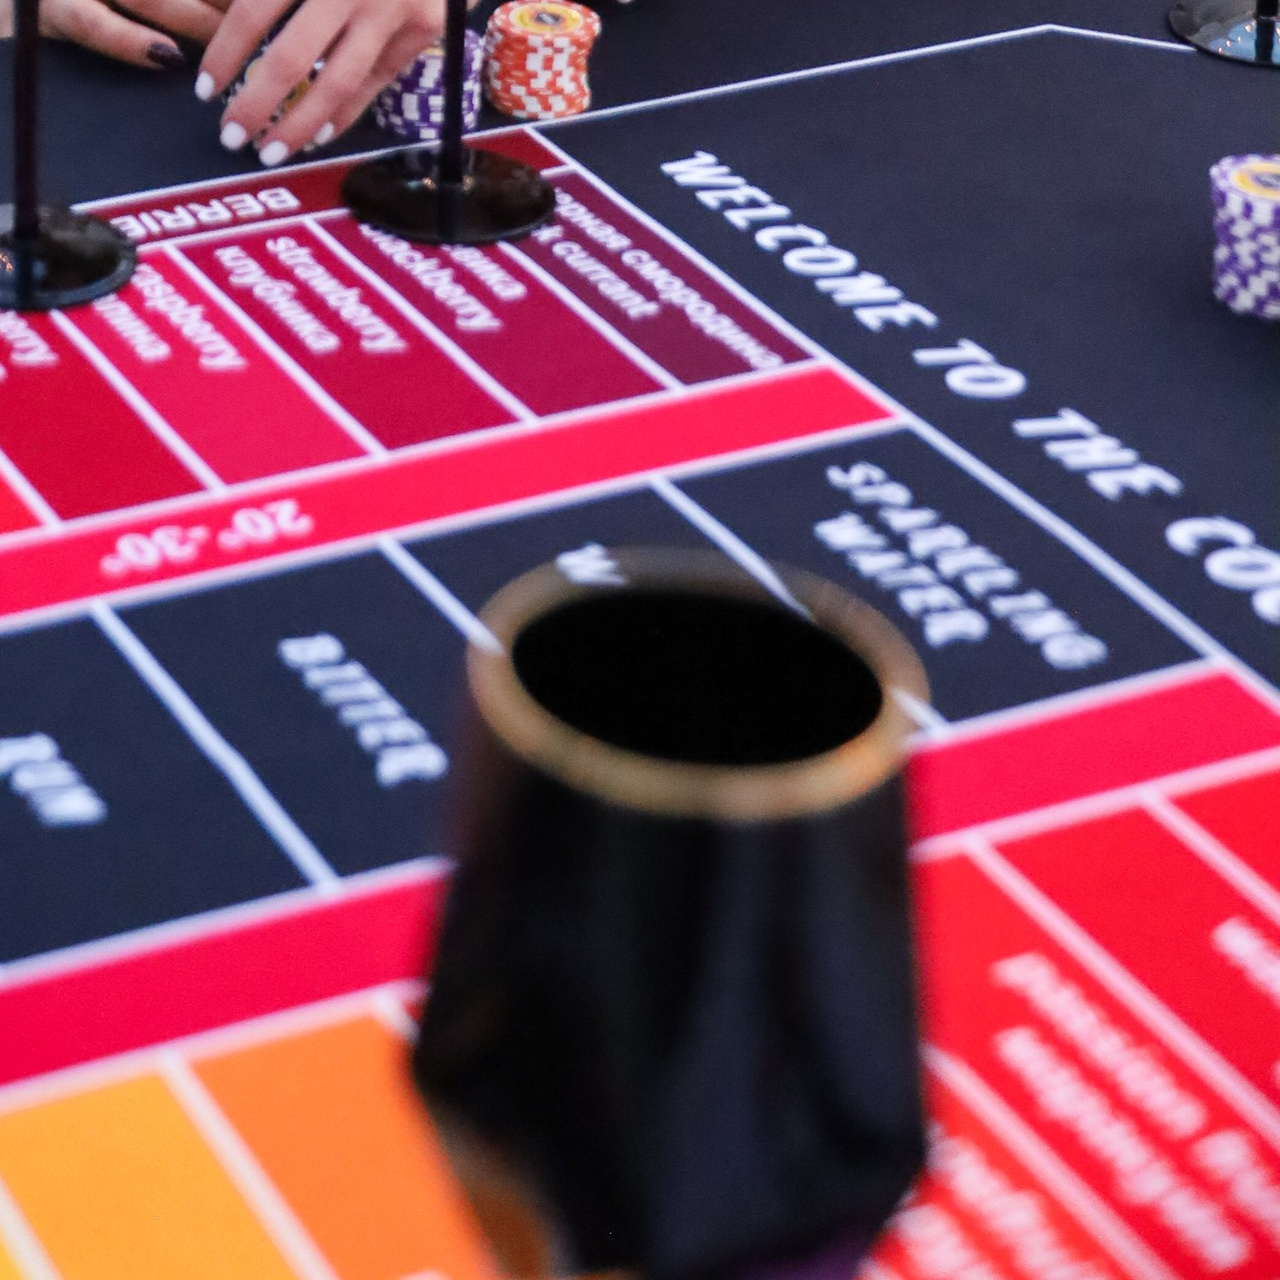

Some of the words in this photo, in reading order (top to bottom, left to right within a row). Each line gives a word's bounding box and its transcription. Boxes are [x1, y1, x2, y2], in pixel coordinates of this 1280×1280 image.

[267, 237, 406, 354] strawberry
[551, 239, 662, 320] currant
[660, 149, 937, 334] WELCOME
[913, 337, 1029, 401] TO
[1013, 407, 1183, 499] THE
[812, 513, 991, 647] WATER
[826, 461, 1110, 672] SPARKLING
